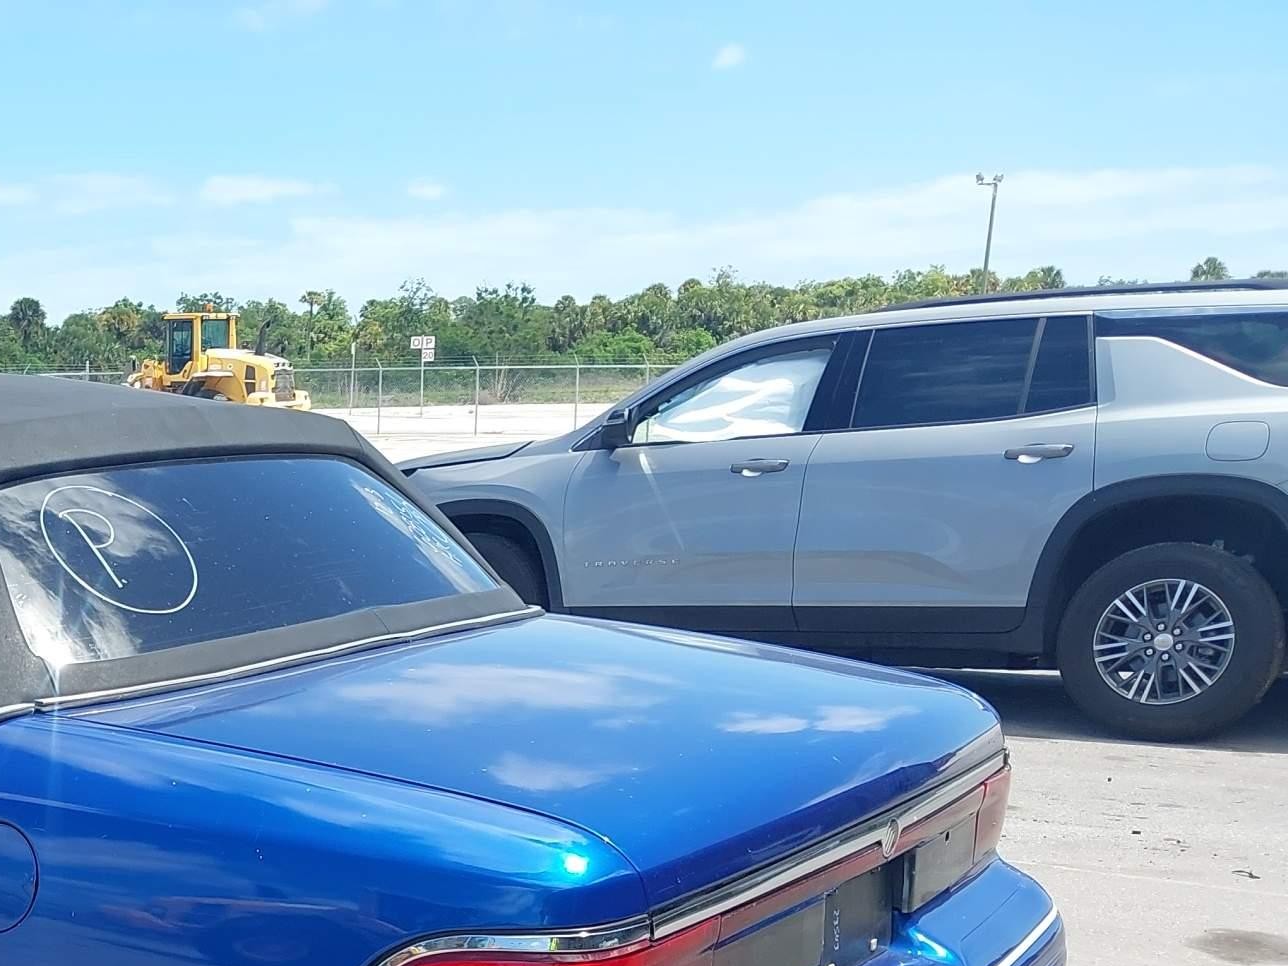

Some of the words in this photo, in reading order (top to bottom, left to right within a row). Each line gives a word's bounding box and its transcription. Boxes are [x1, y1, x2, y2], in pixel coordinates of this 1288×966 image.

[412, 337, 421, 348] O
[425, 337, 433, 347] P
[422, 351, 434, 360] 20
[583, 558, 681, 569] TRAVERSE
